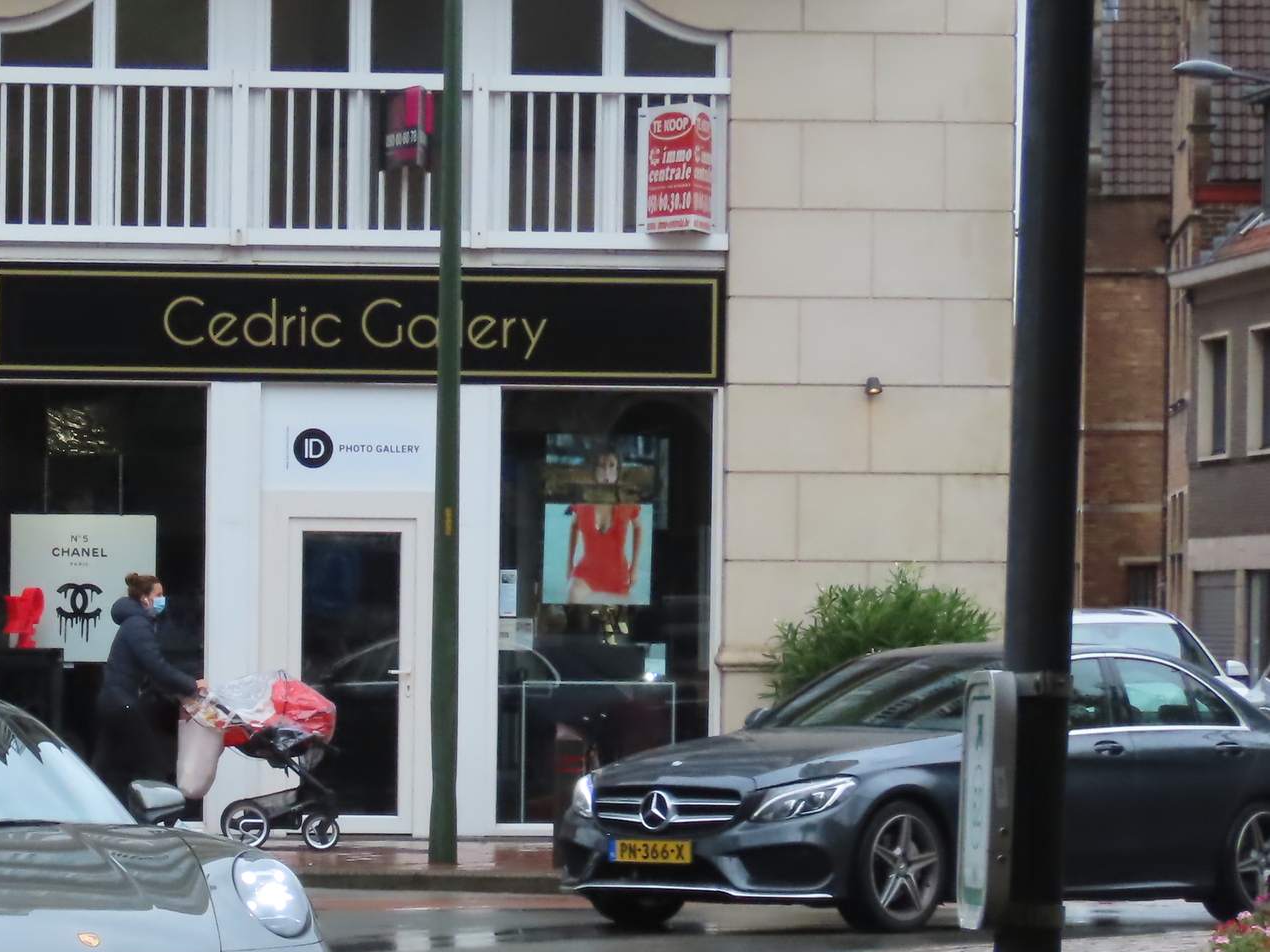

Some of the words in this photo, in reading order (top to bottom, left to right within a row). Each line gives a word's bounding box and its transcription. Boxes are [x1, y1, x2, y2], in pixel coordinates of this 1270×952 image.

[653, 120, 662, 133] TE
[664, 117, 689, 132] KOOP
[662, 146, 692, 164] immo
[649, 162, 692, 183] centrale
[163, 296, 341, 347] Cedric
[361, 299, 547, 360] Galery
[304, 438, 325, 459] ID
[338, 444, 373, 453] PHOTO
[376, 445, 420, 454] GALLERY
[51, 547, 108, 558] CHANEL
[620, 842, 685, 860] PN-366-X
